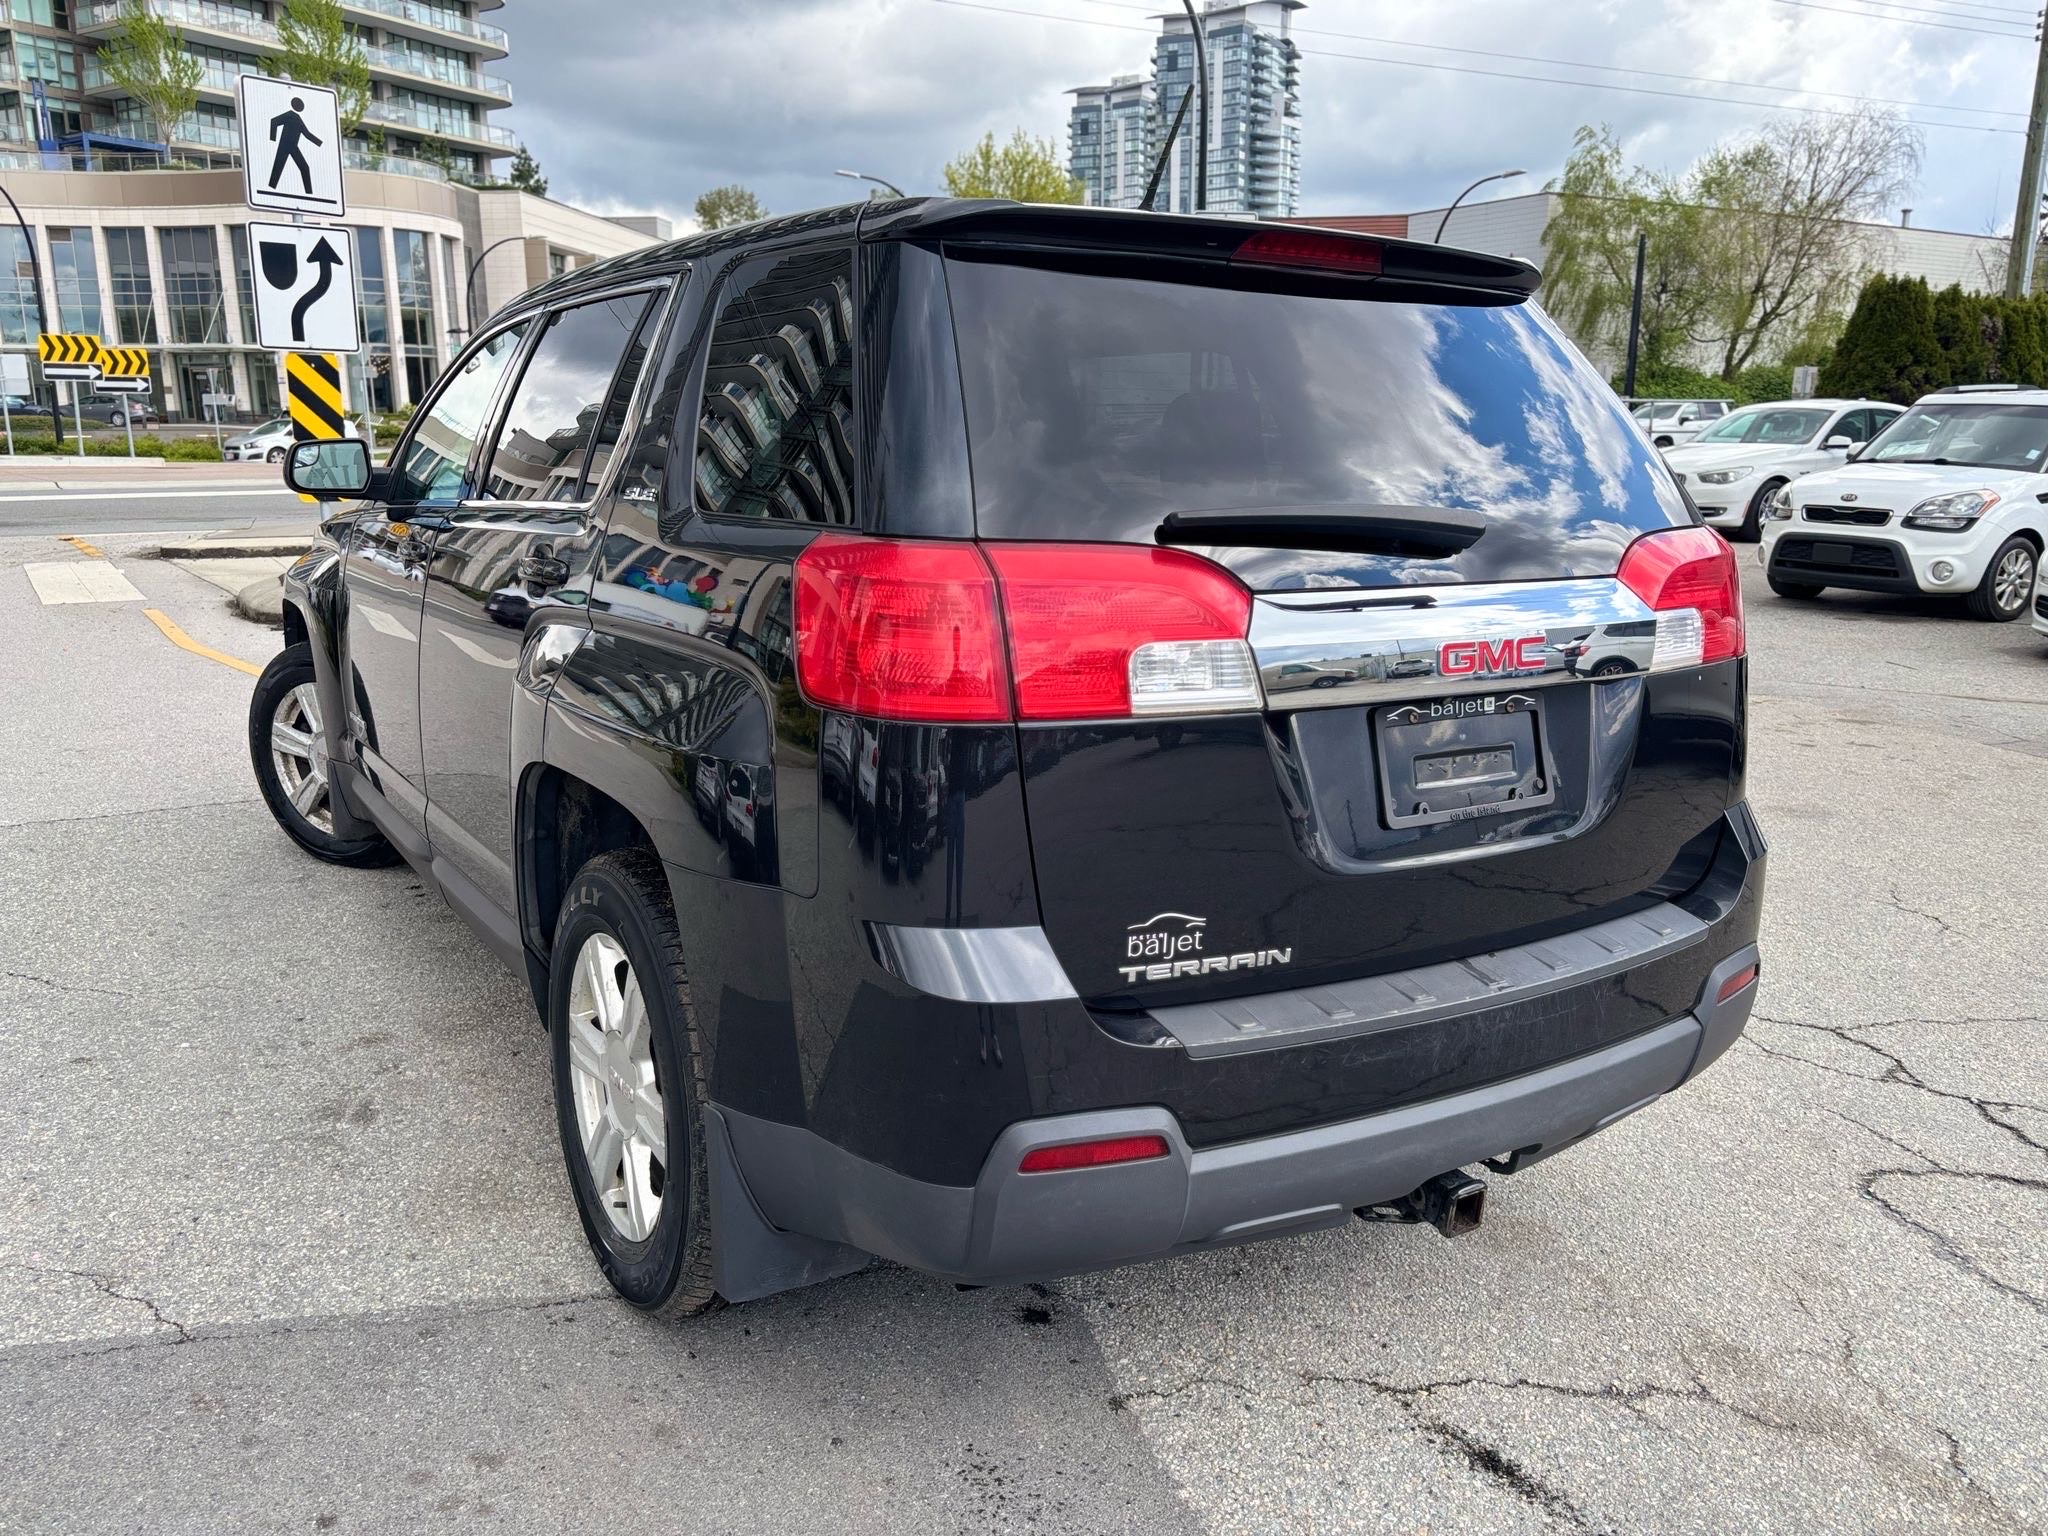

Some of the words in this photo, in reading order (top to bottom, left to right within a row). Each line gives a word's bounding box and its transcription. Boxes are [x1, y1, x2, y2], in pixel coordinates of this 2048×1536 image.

[1437, 635, 1547, 676] GMC
[1132, 932, 1164, 940] PETER
[1119, 948, 1292, 983] TERRAIN
